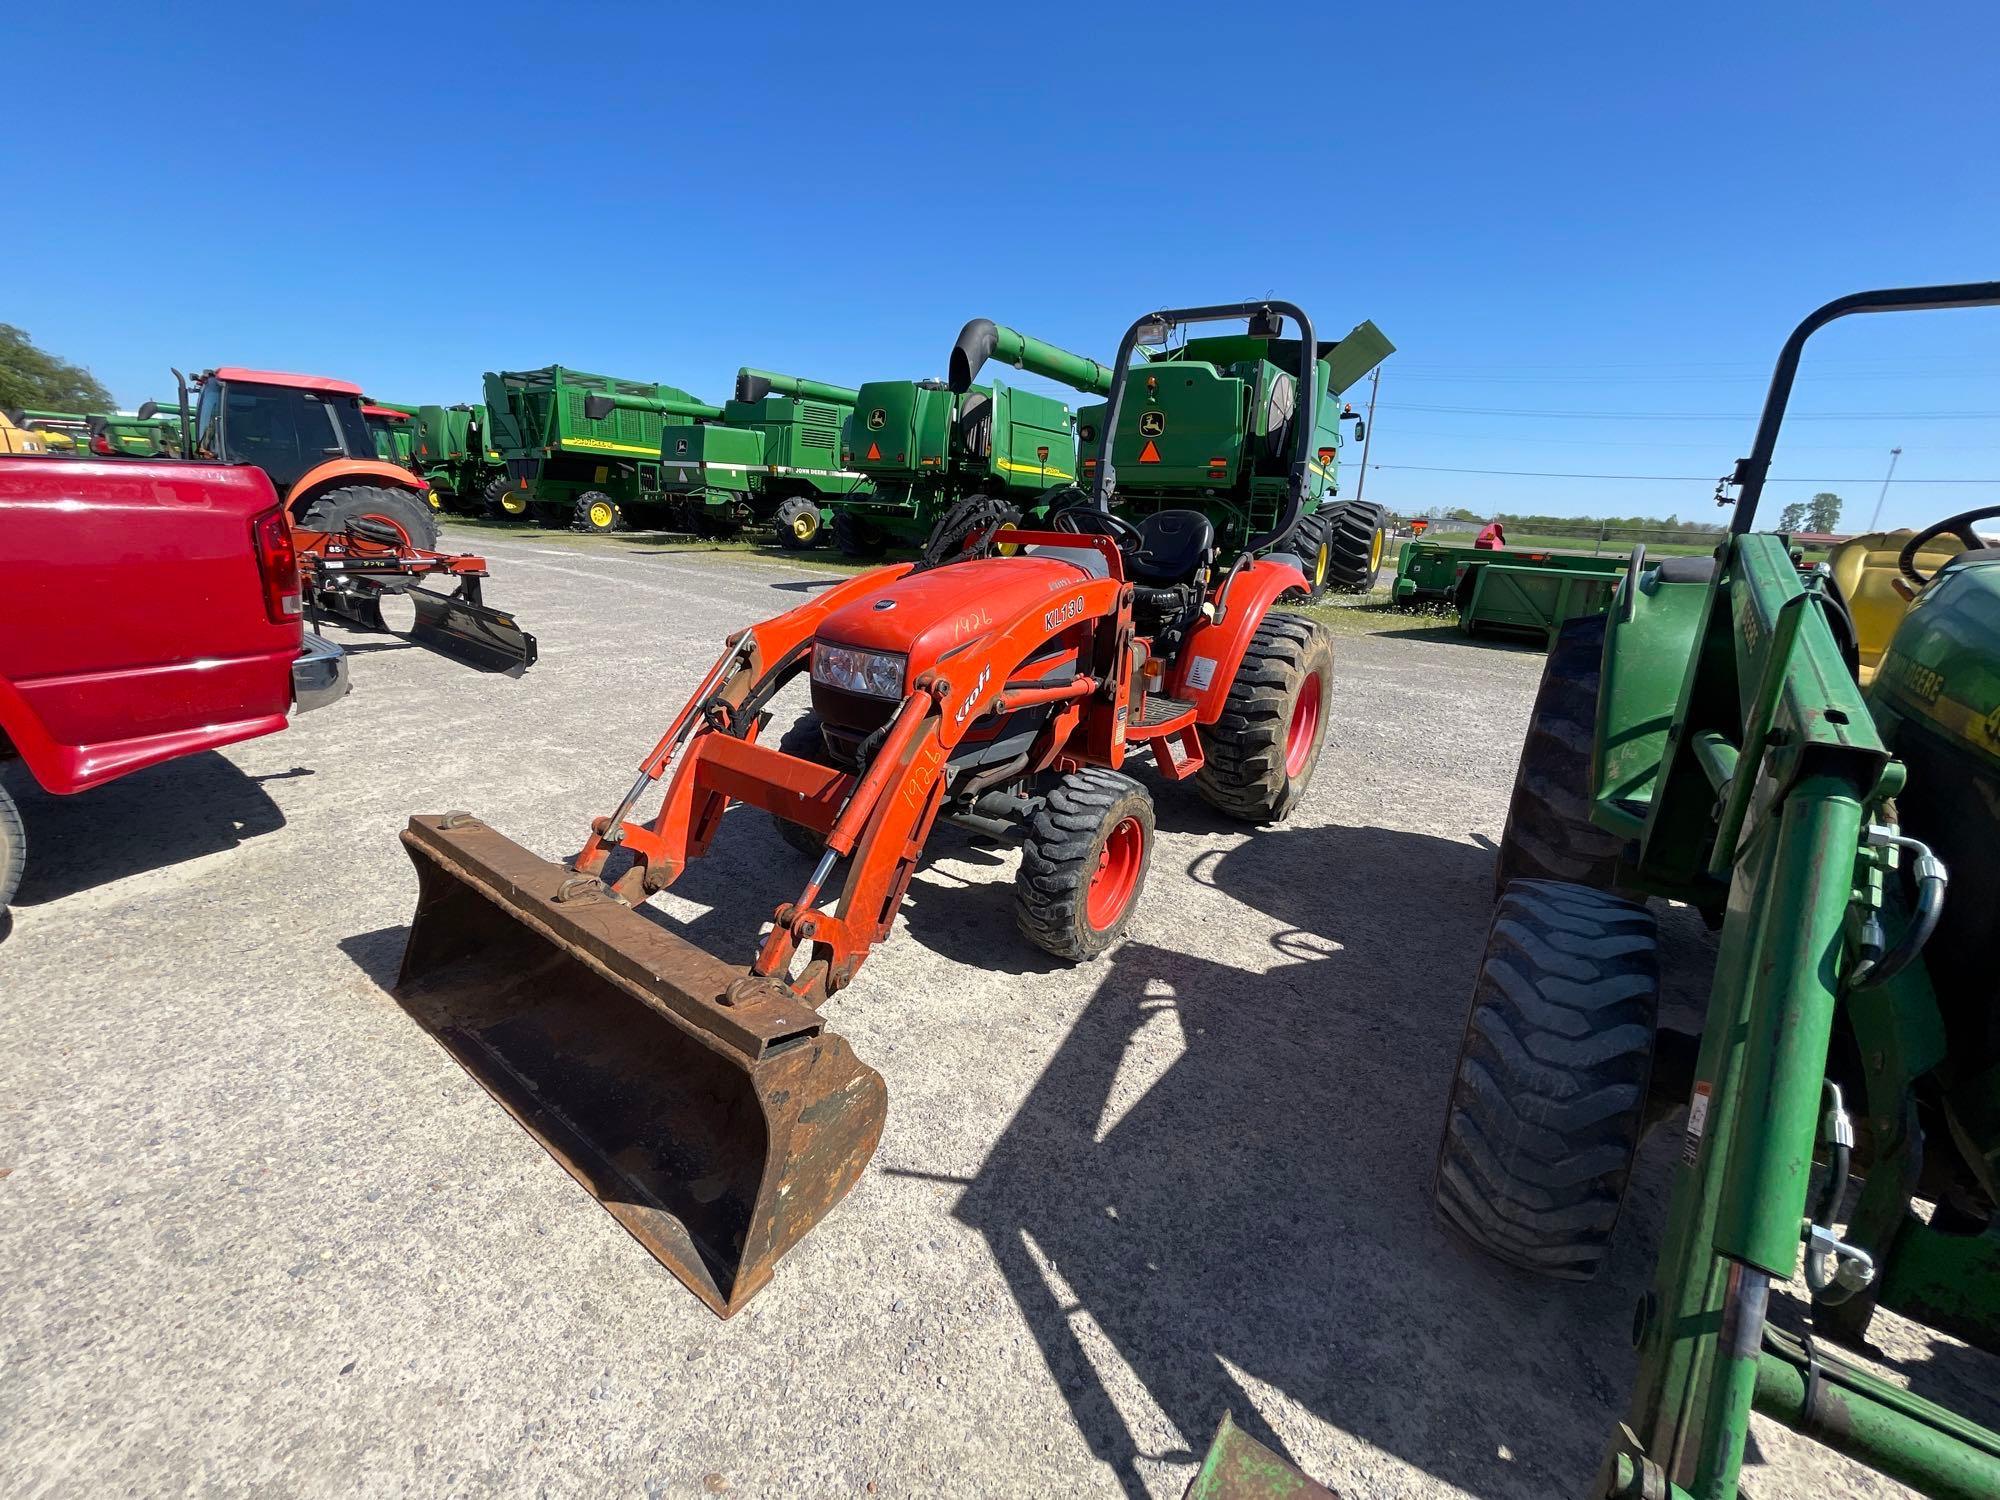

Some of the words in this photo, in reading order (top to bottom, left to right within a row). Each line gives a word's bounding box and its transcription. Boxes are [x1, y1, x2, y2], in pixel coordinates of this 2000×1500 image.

[796, 467, 810, 475] JOHN
[810, 468, 827, 476] DEERE
[954, 607, 993, 641] 1926
[1045, 595, 1085, 632] KL130
[1905, 661, 1945, 701] DEERE
[902, 749, 941, 809] 1926
